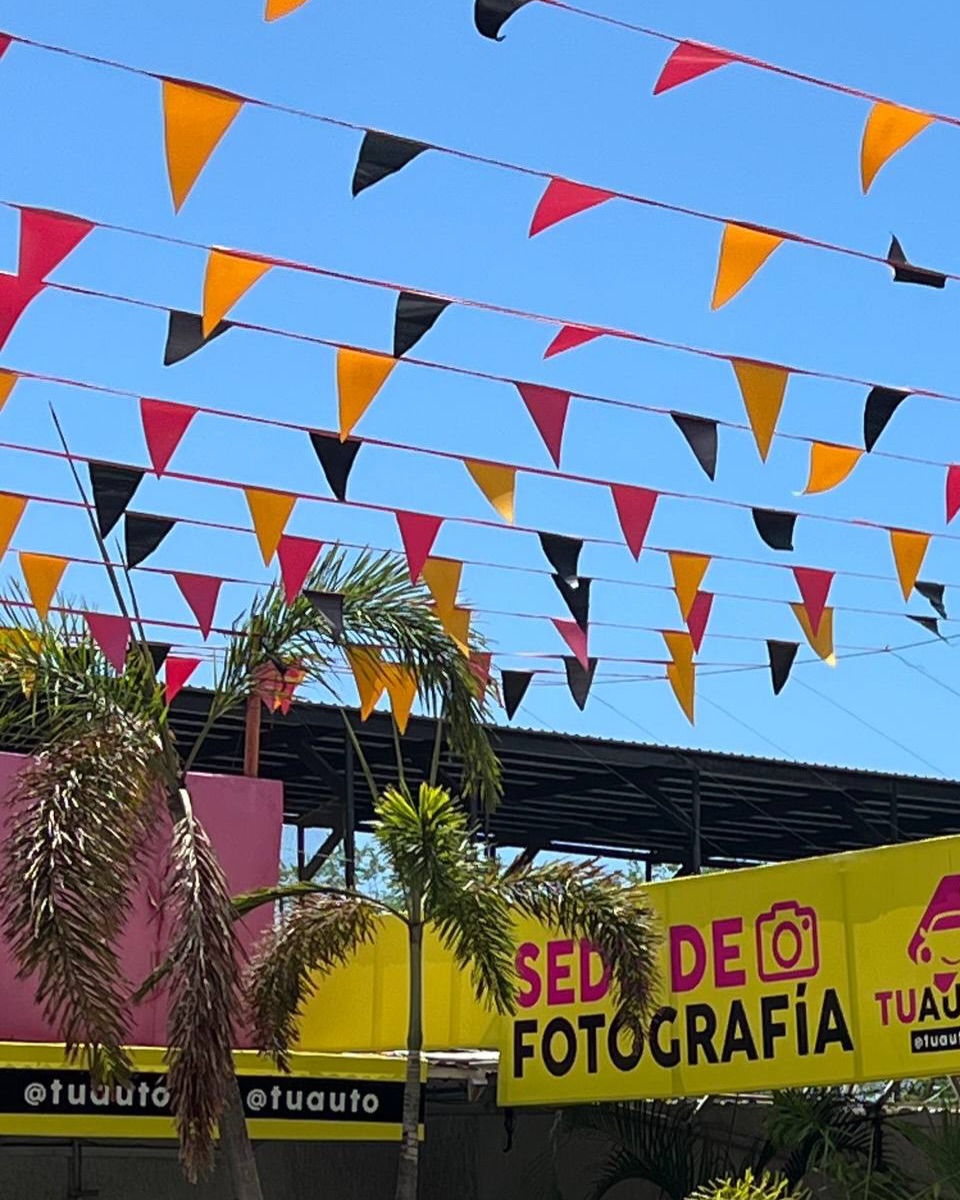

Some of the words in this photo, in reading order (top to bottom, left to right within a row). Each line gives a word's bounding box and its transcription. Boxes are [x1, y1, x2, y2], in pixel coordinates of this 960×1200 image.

[669, 917, 747, 993] DE
[513, 982, 855, 1079] FOTOGRAFÍA
[246, 1085, 380, 1114] @tuauto
